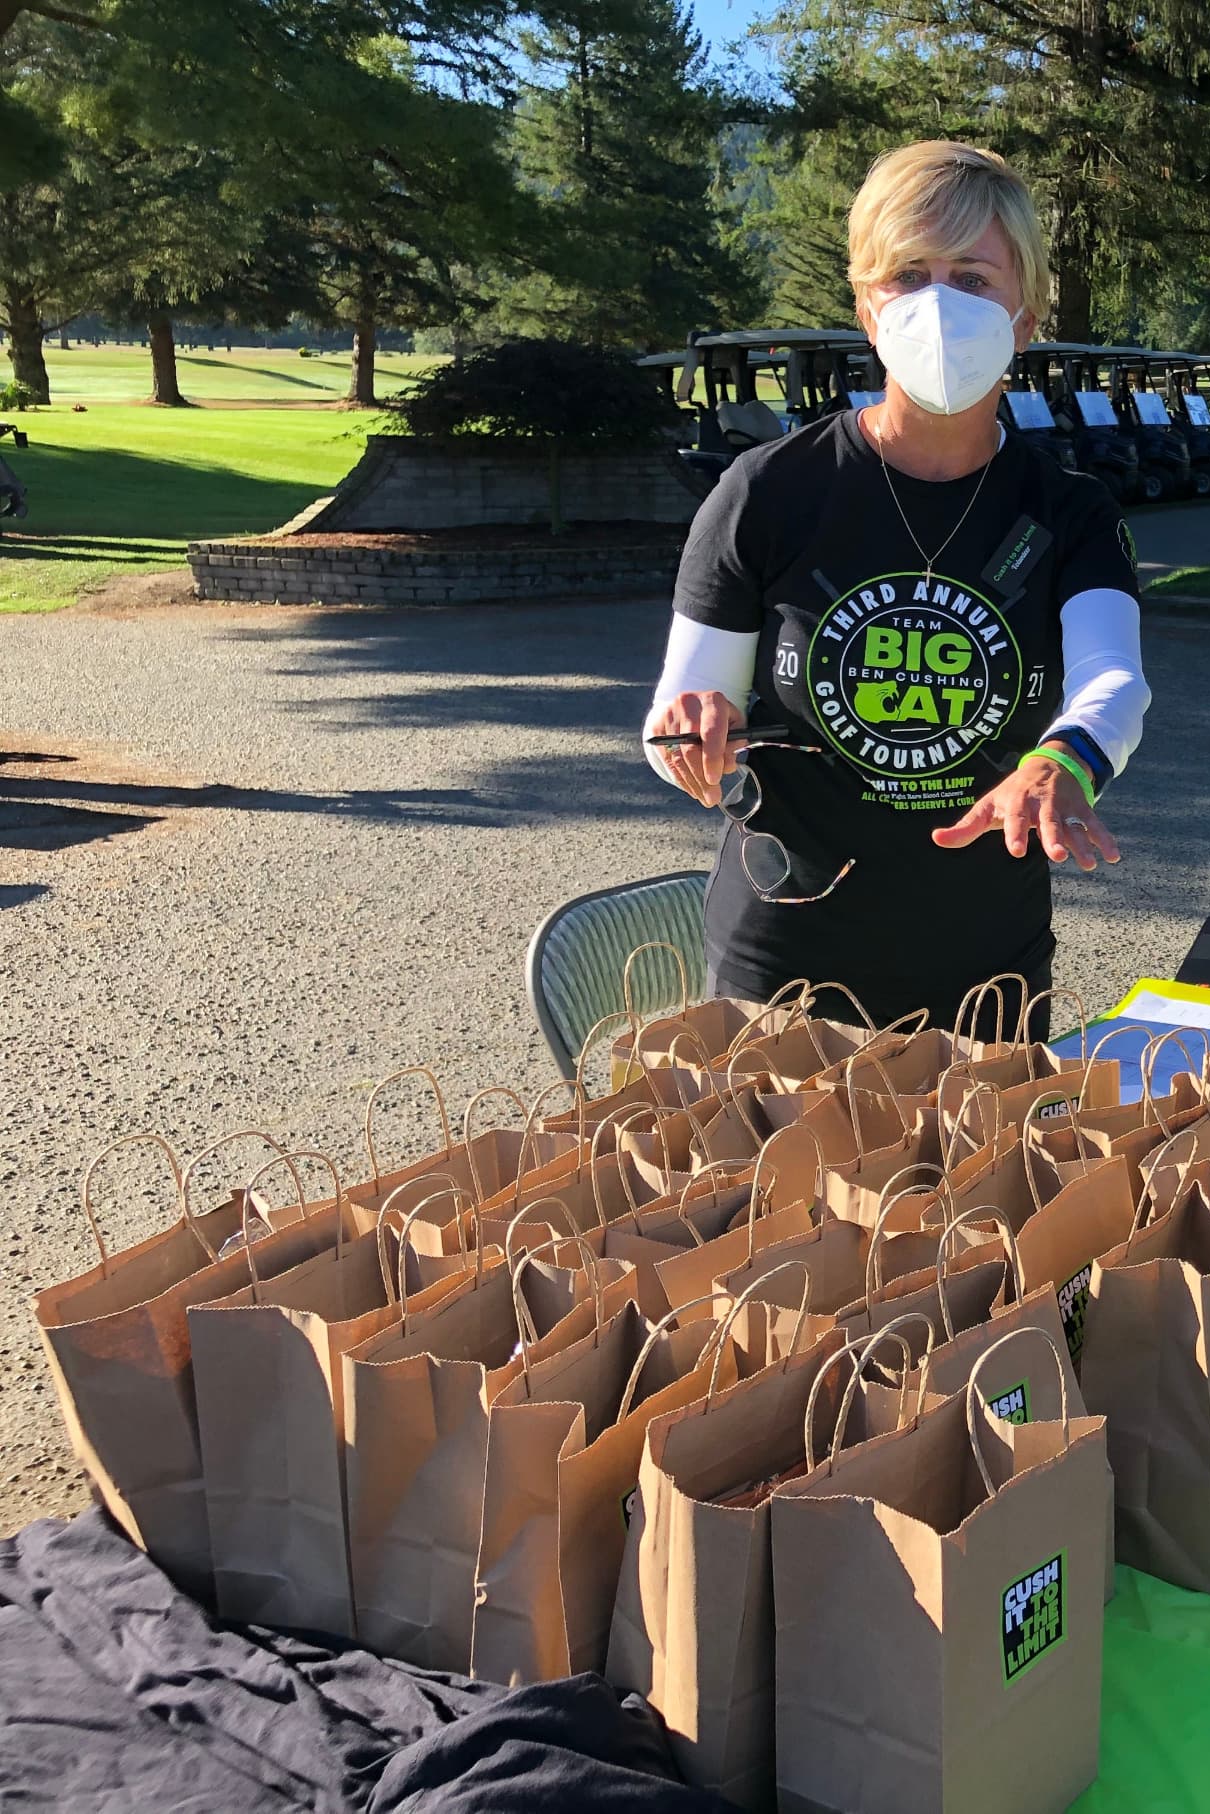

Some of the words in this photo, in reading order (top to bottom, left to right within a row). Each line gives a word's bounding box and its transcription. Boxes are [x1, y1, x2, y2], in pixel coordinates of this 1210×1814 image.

[822, 583, 896, 642] THIRD
[912, 581, 1008, 656] ANNUAL
[892, 617, 942, 630] TEAM
[777, 649, 798, 678] 20
[864, 625, 972, 675] BIG
[848, 667, 885, 681] BEN
[895, 671, 984, 688] CUSHING
[1026, 672, 1044, 698] 21
[854, 680, 976, 726] CAT
[815, 681, 859, 741] GOLF
[858, 693, 1010, 769] TOURNAMENT
[861, 791, 876, 801] ALL
[911, 799, 946, 810] DESERVE
[948, 798, 955, 807] A
[887, 781, 899, 792] IT
[900, 781, 918, 792] TO
[919, 779, 943, 792] THE
[945, 776, 975, 790] LIMIT
[1058, 1266, 1090, 1307] CUSH
[1060, 1299, 1074, 1324] IT
[1004, 1559, 1059, 1611] CUSH
[1005, 1601, 1027, 1634] IT
[1030, 1581, 1059, 1613] TO
[1020, 1598, 1059, 1638] THE
[1007, 1617, 1060, 1674] LIMIT
